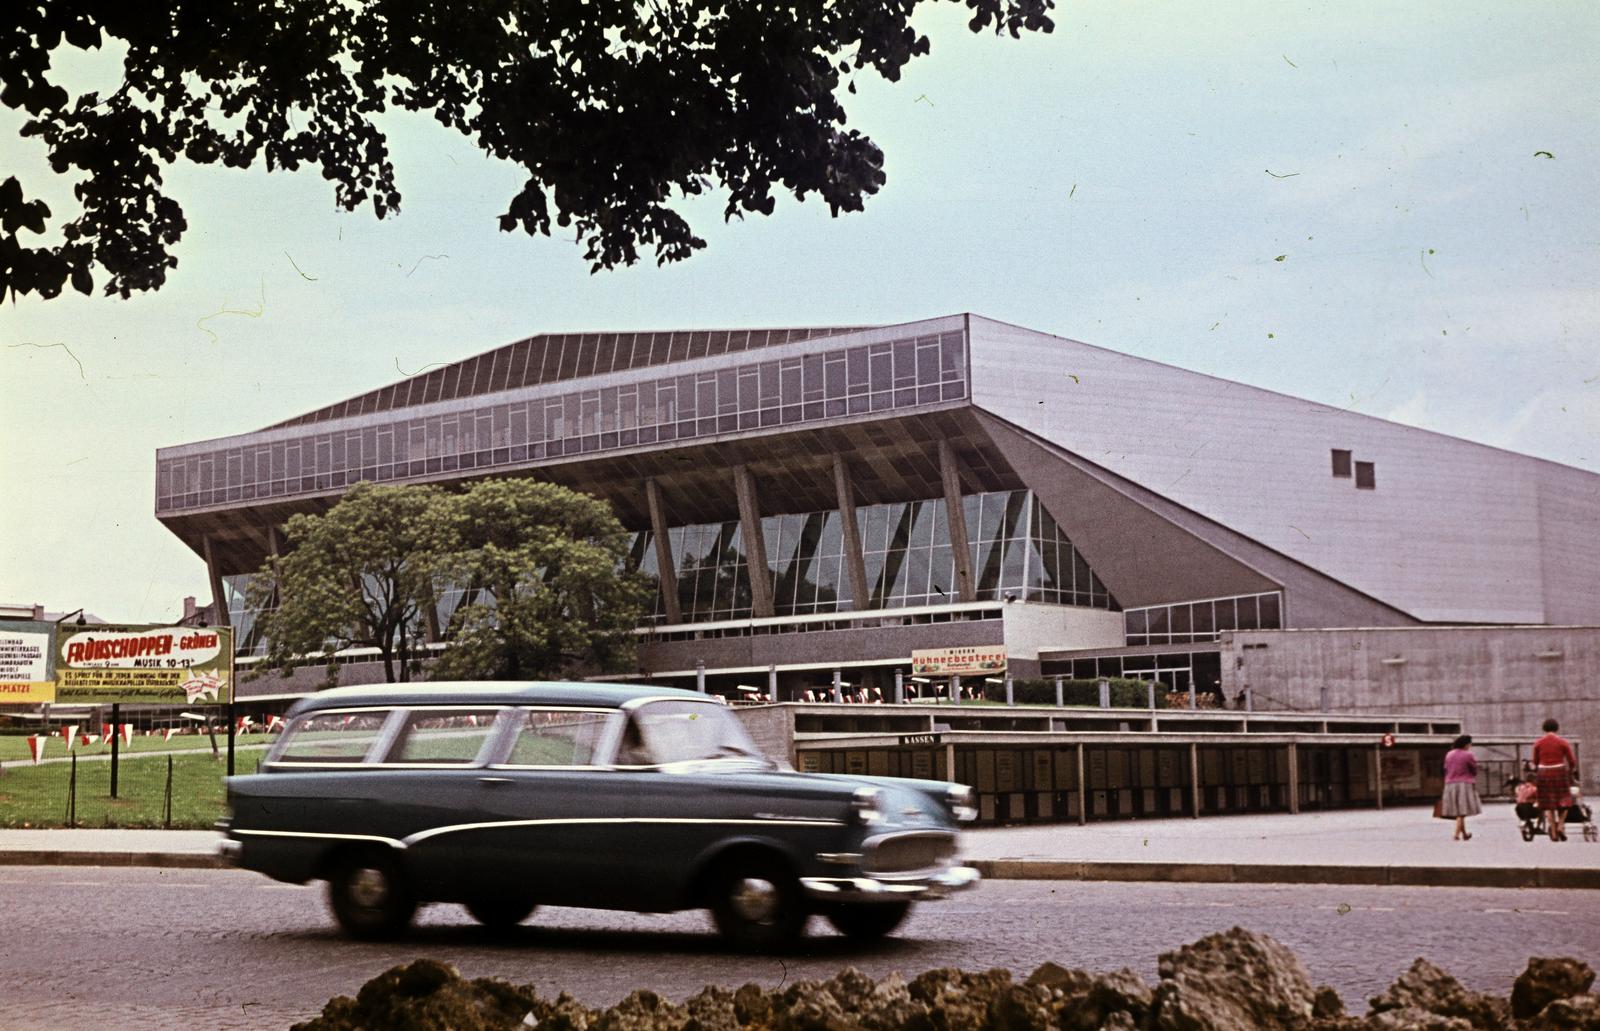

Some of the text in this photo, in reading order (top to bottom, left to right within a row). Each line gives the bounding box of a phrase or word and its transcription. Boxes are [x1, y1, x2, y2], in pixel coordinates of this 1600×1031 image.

[66, 635, 173, 663] FRÜHSCHOPPEN
[180, 632, 217, 650] GRÜNEN
[134, 658, 161, 667] MUSIK
[904, 735, 935, 744] KASSEN
